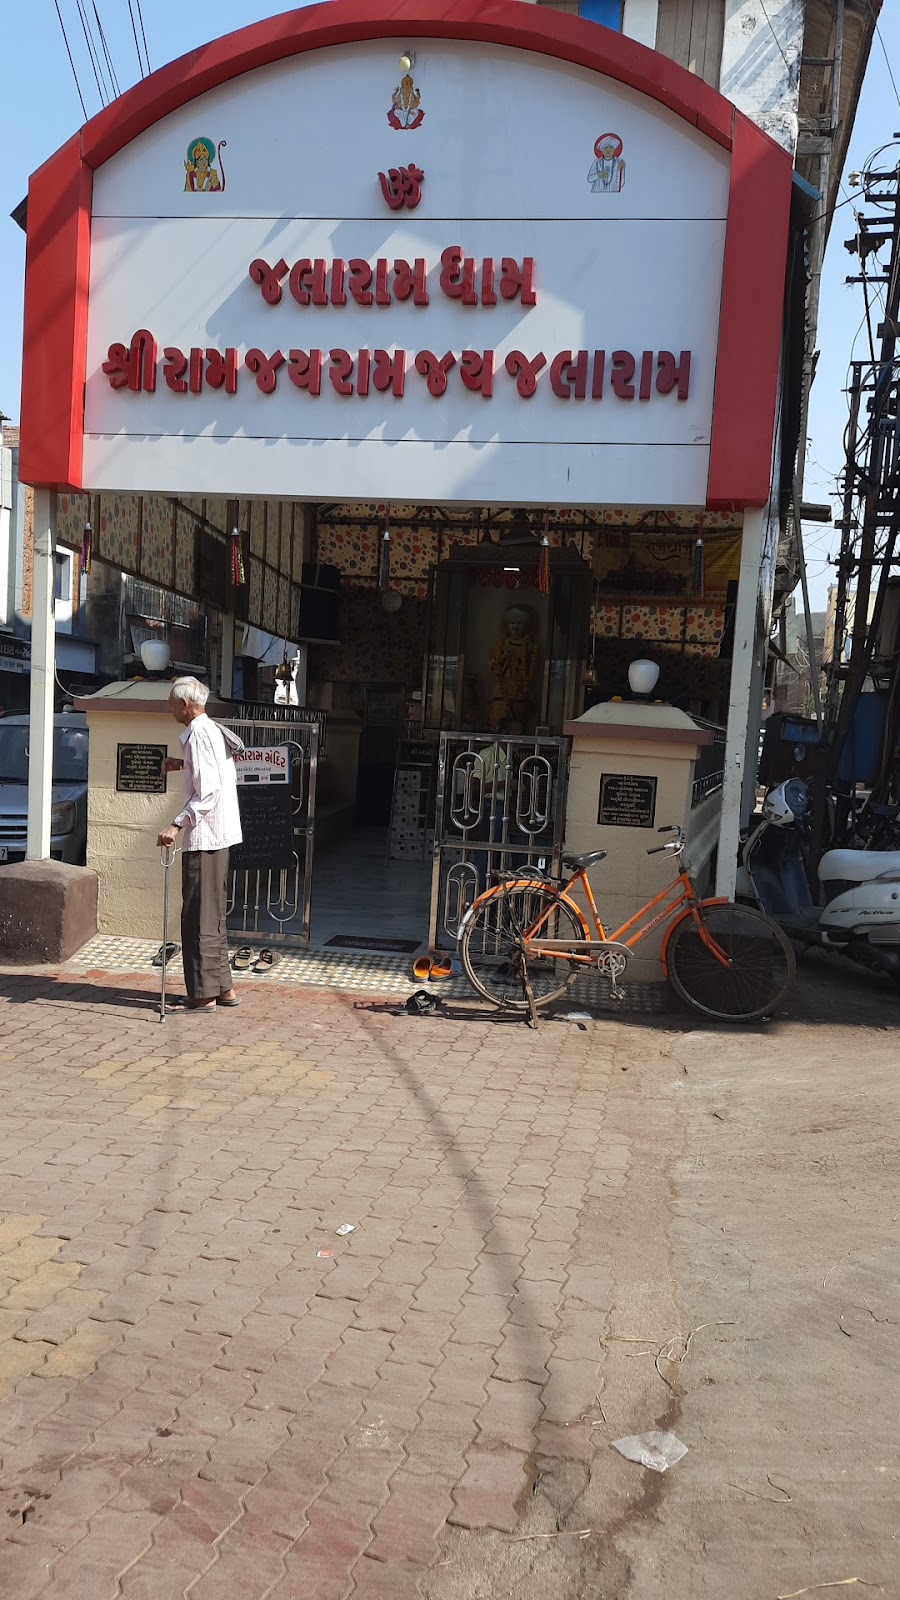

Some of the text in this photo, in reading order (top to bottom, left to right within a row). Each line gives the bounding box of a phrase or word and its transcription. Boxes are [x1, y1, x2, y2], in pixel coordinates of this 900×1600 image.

[249, 245, 539, 309] જલારામ ધામ
[504, 351, 693, 402] જલારામ
[264, 750, 286, 768] મંદિર
